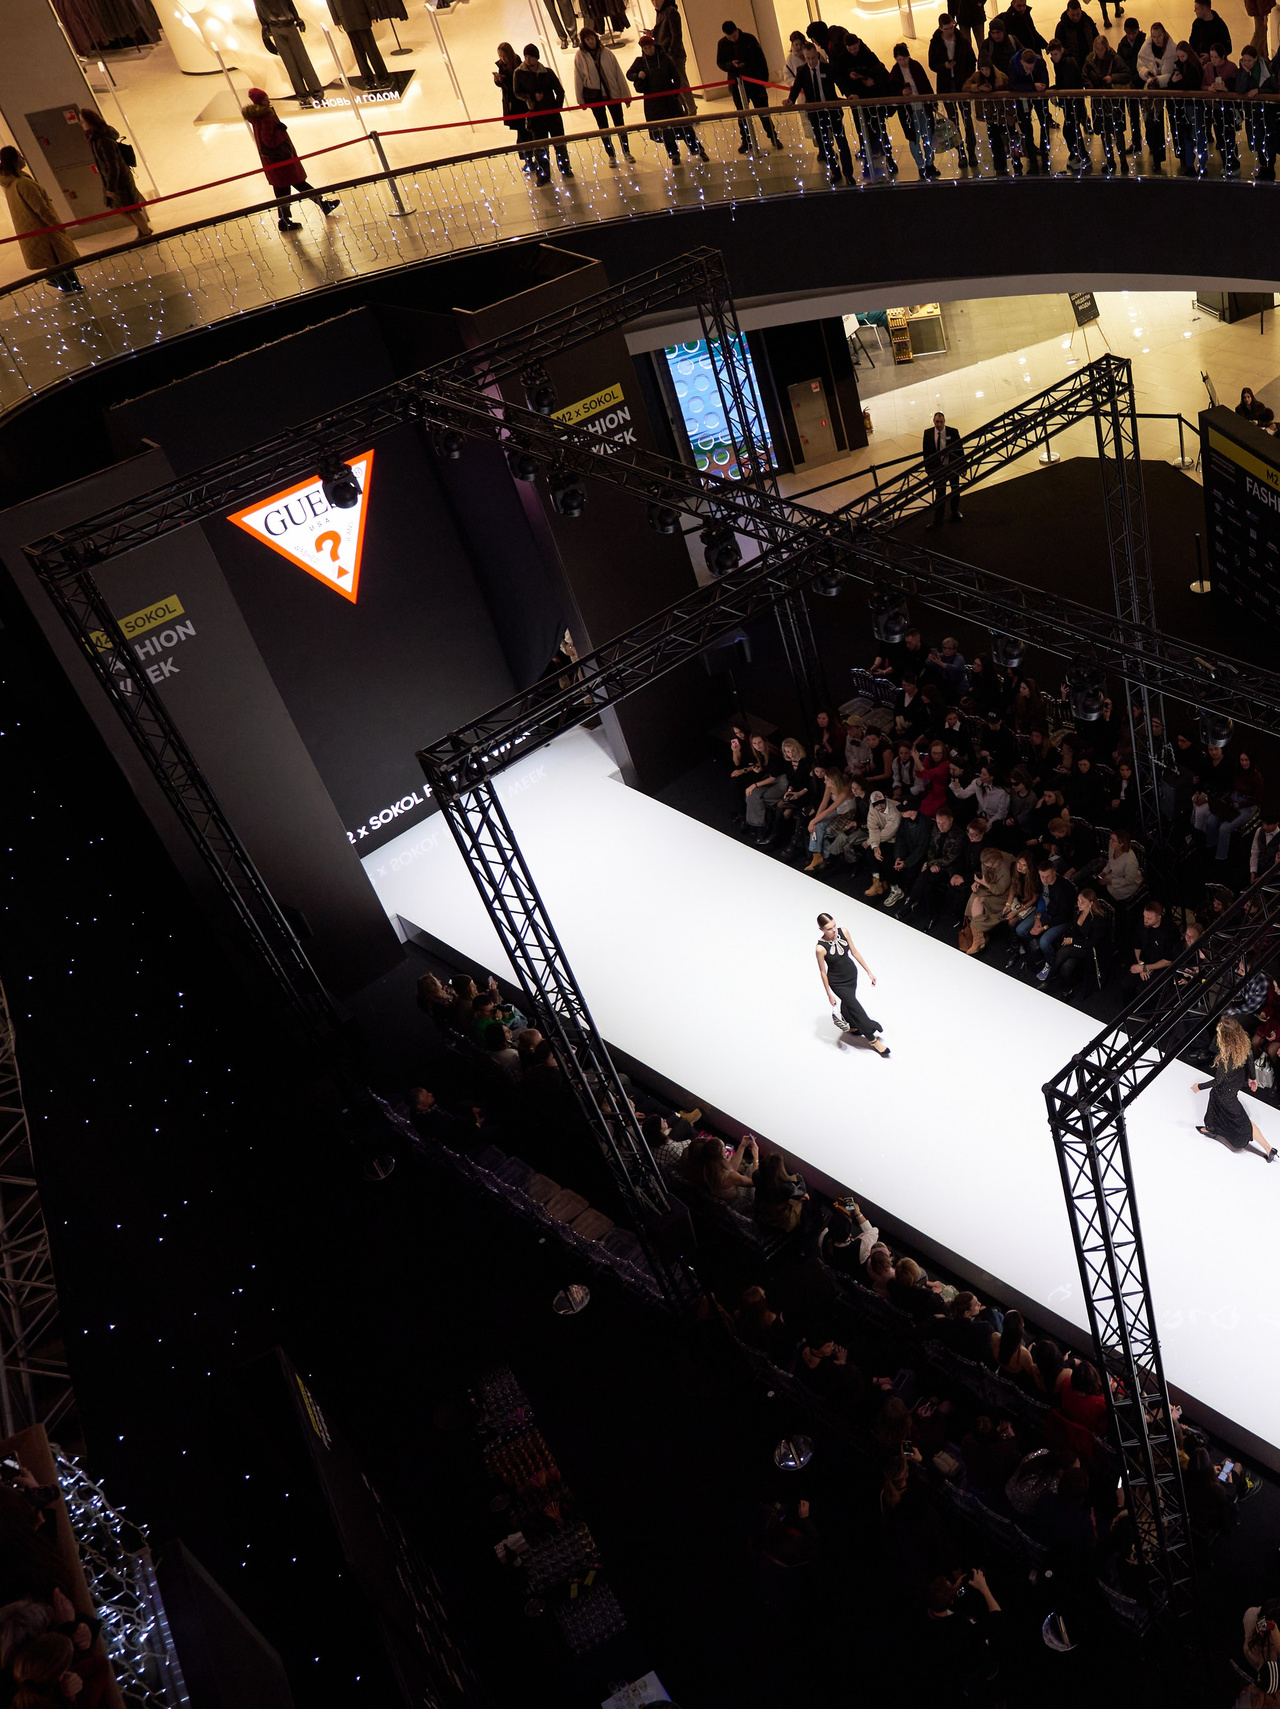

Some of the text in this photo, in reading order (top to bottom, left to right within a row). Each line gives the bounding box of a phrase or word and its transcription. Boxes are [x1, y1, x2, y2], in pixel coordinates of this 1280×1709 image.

[363, 90, 400, 103] ГОДОМ
[574, 408, 581, 417] x
[582, 390, 619, 413] SOKOL
[1266, 469, 1279, 486] M2
[264, 489, 330, 536] GUE
[309, 517, 331, 532] USA
[124, 604, 177, 633] SOKOL
[358, 825, 370, 839] x
[369, 792, 424, 830] SOKOL
